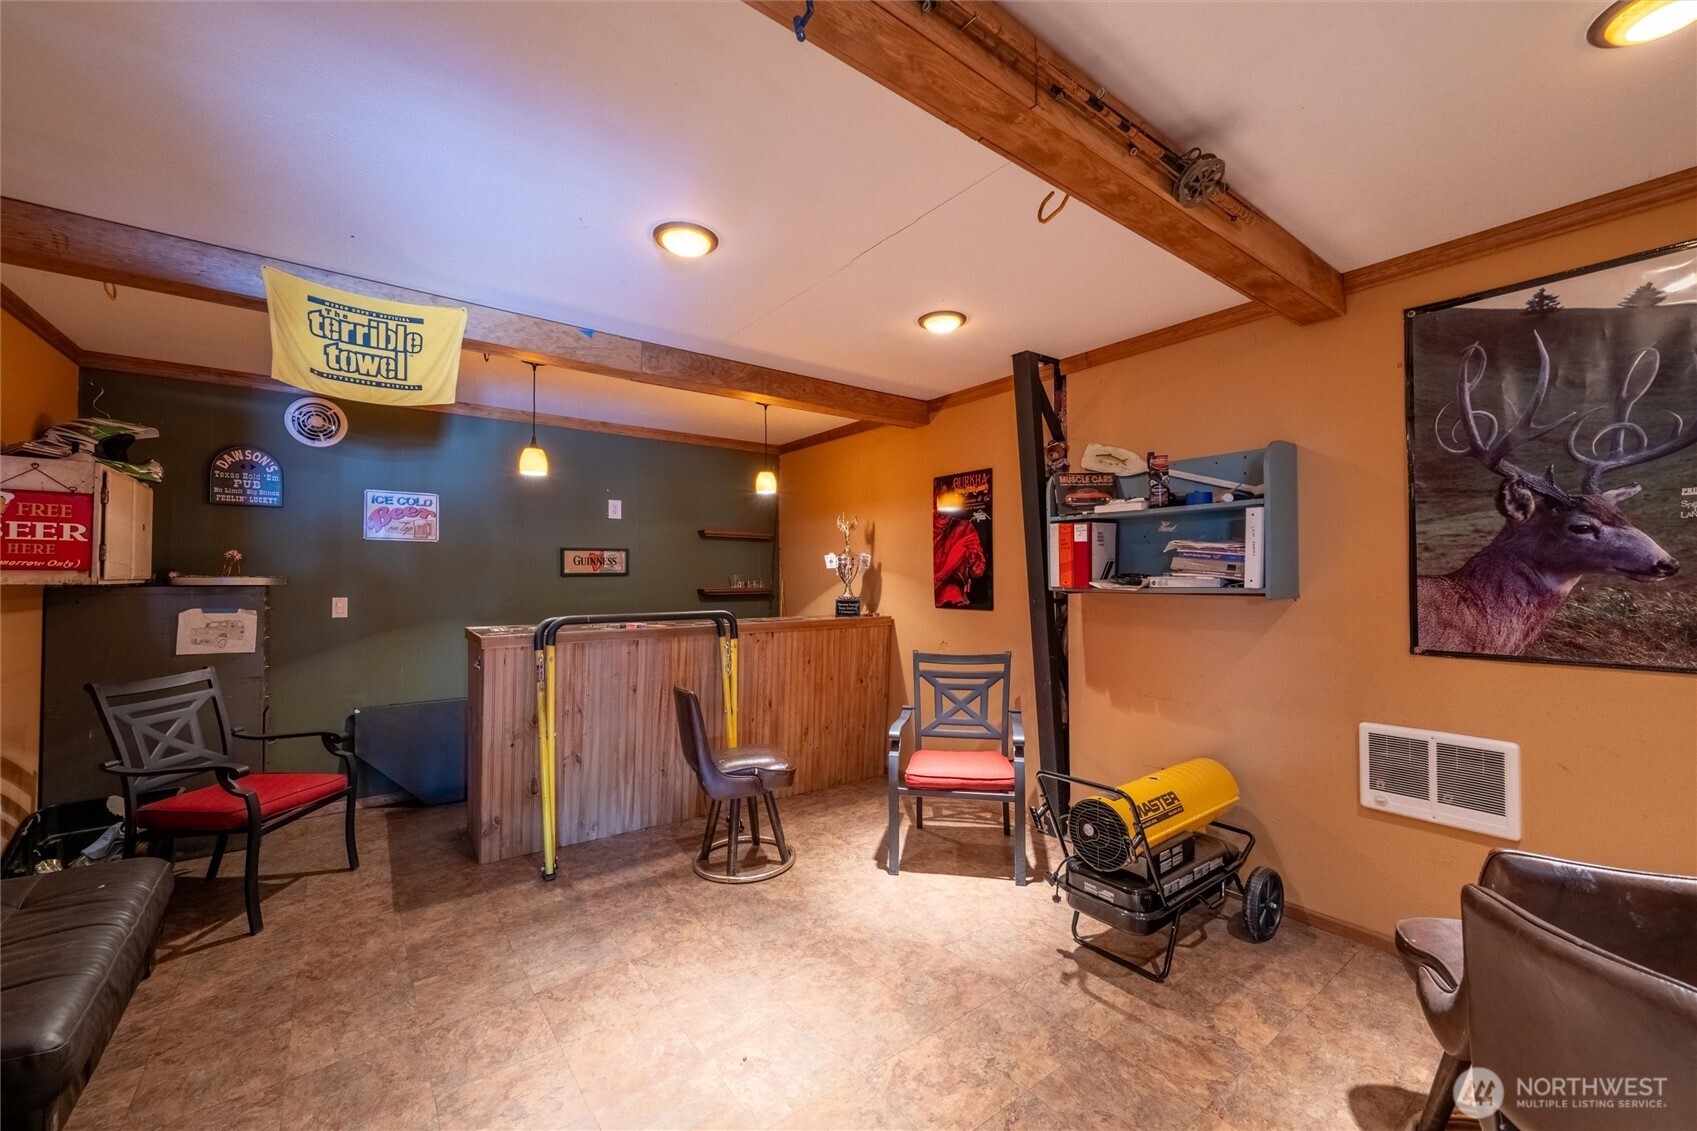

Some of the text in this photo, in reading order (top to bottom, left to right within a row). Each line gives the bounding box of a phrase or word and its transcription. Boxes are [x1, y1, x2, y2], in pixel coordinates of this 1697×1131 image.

[325, 308, 348, 319] The
[308, 309, 423, 354] terrible
[323, 342, 408, 381] towel
[216, 450, 278, 472] DAWSON'S
[233, 479, 261, 488] PUB
[1059, 475, 1114, 483] MUSCLE CARS
[371, 495, 433, 507] ICE COLD
[16, 502, 72, 517] FREE
[367, 506, 437, 533] Beer
[0, 521, 88, 541] EER
[7, 543, 55, 554] HERE
[47, 559, 80, 568] Only)
[573, 555, 617, 565] GUINNESS
[1136, 791, 1181, 818] MASTER
